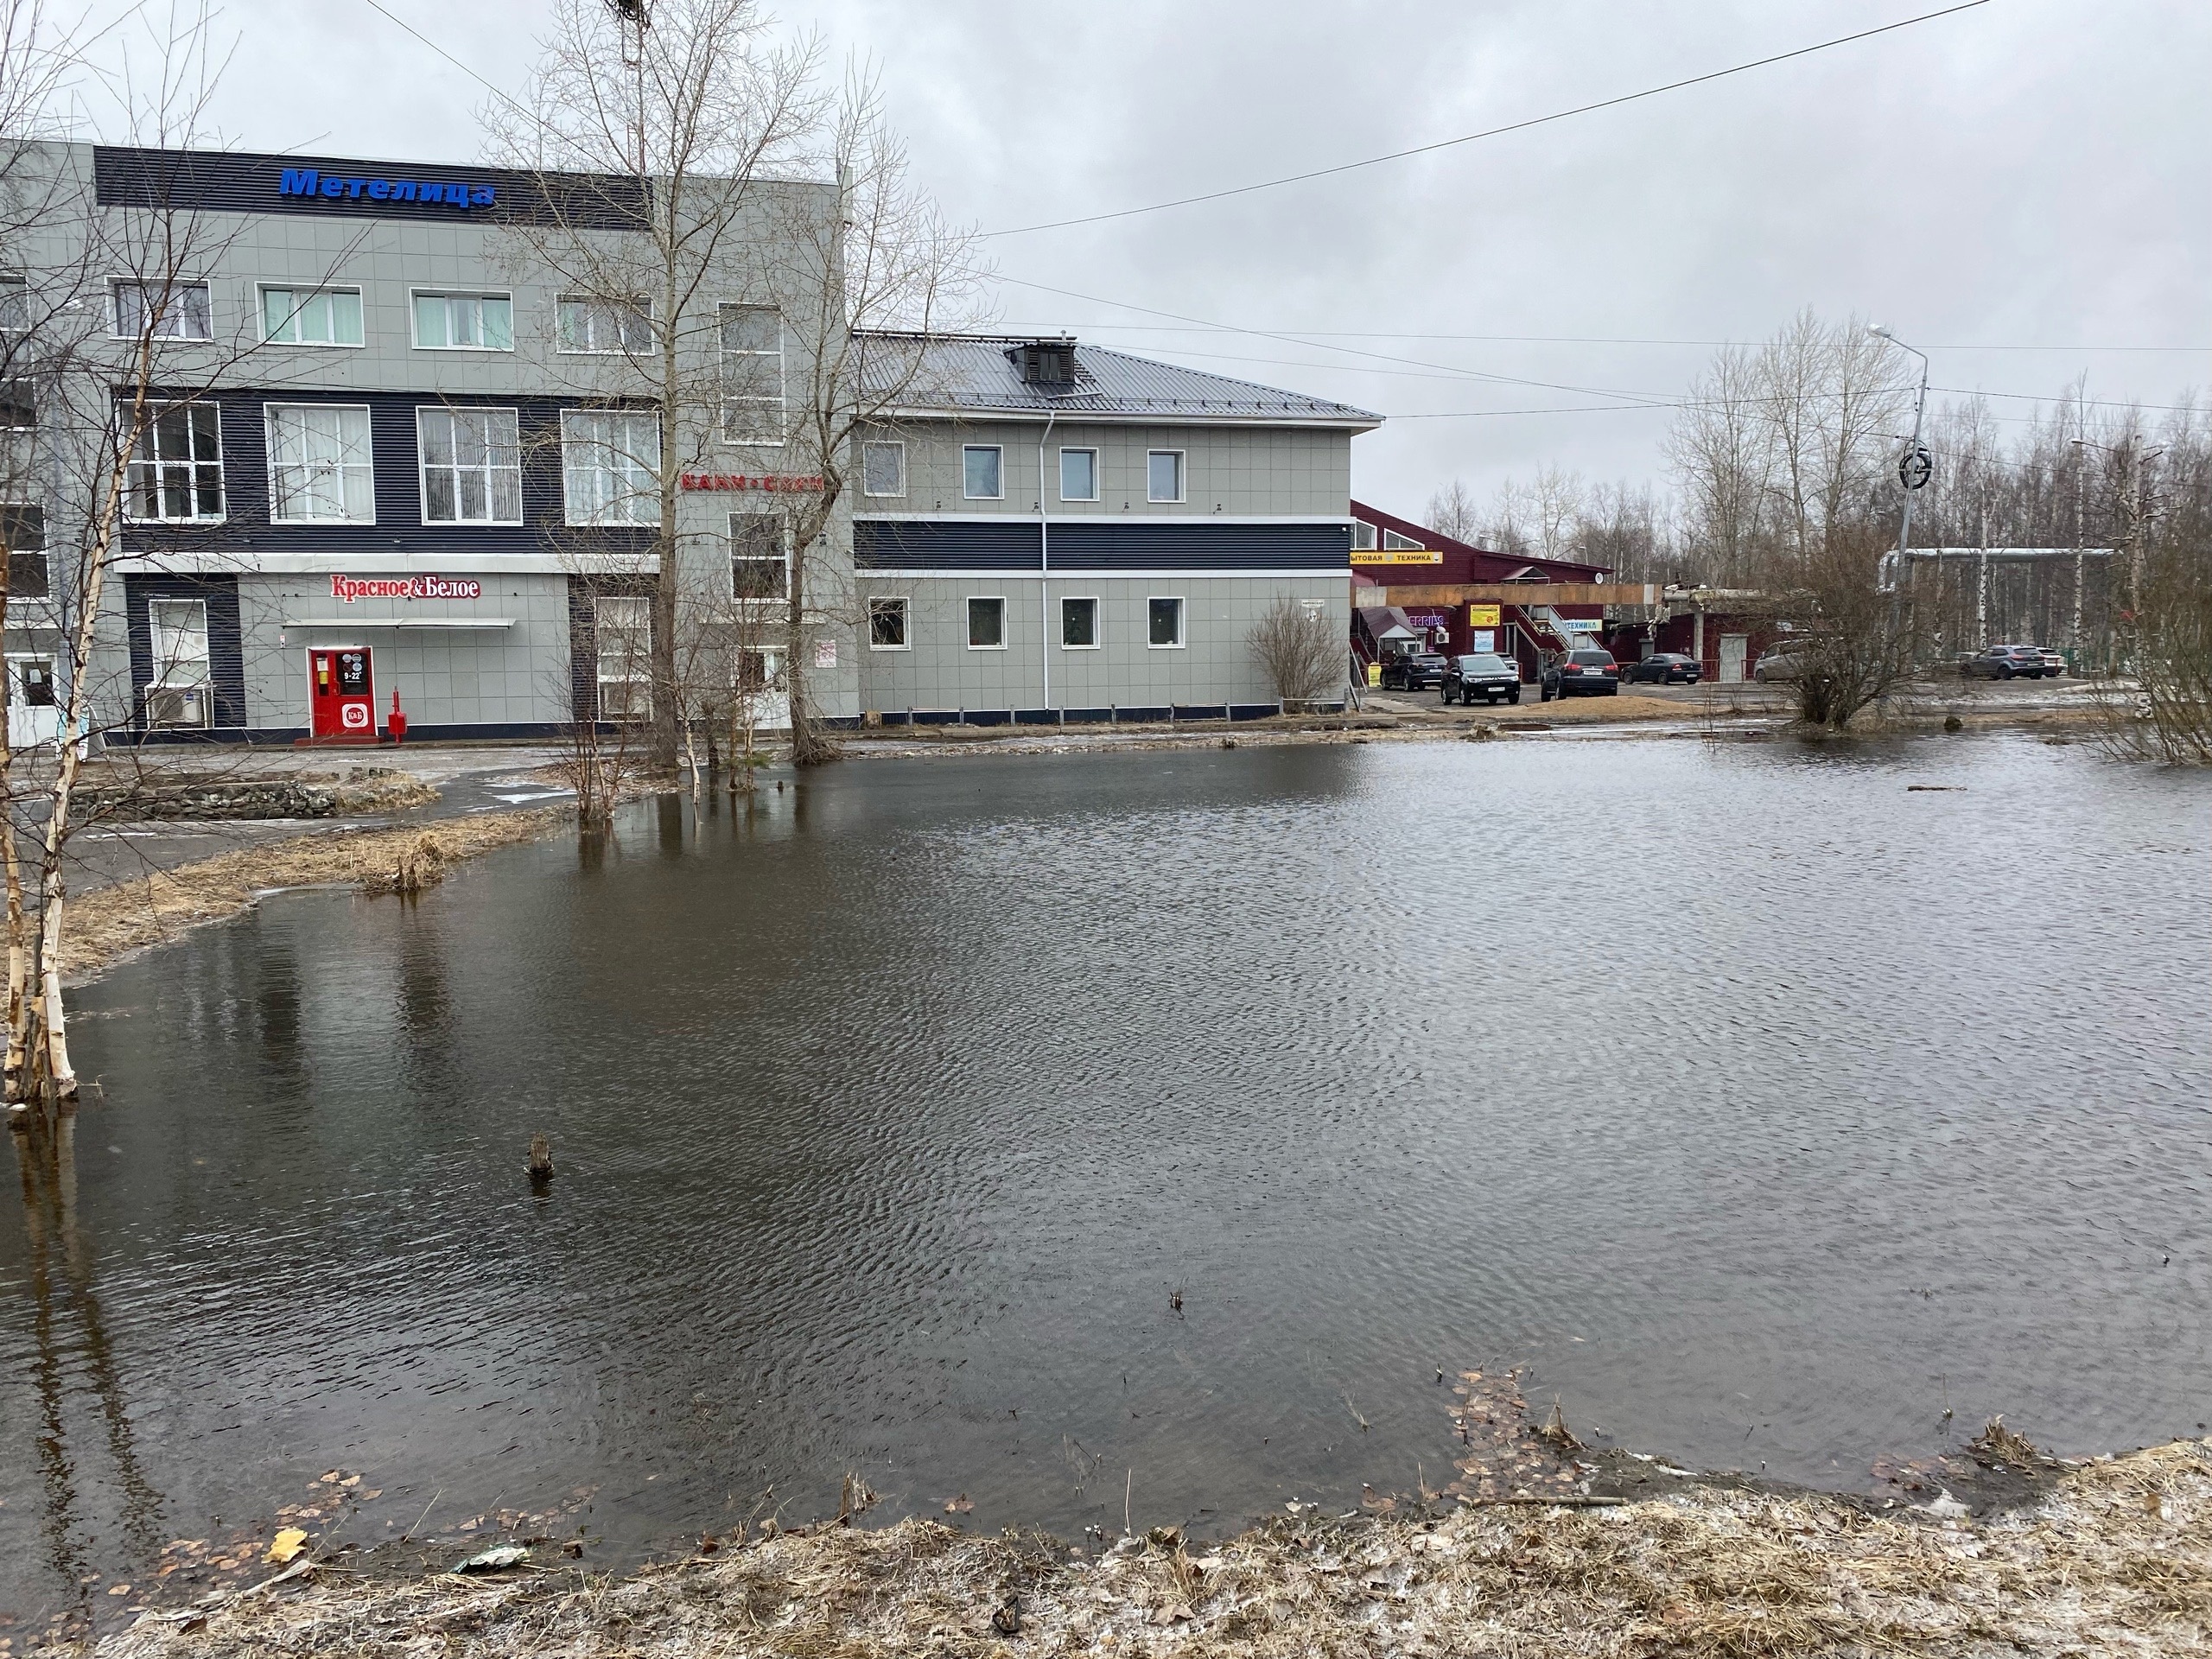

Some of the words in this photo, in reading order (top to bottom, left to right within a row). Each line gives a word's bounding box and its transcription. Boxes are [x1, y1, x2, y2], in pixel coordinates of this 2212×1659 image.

[280, 168, 496, 207] Метелица
[1408, 615, 1444, 626] ERRIES
[347, 711, 363, 720] К&Б
